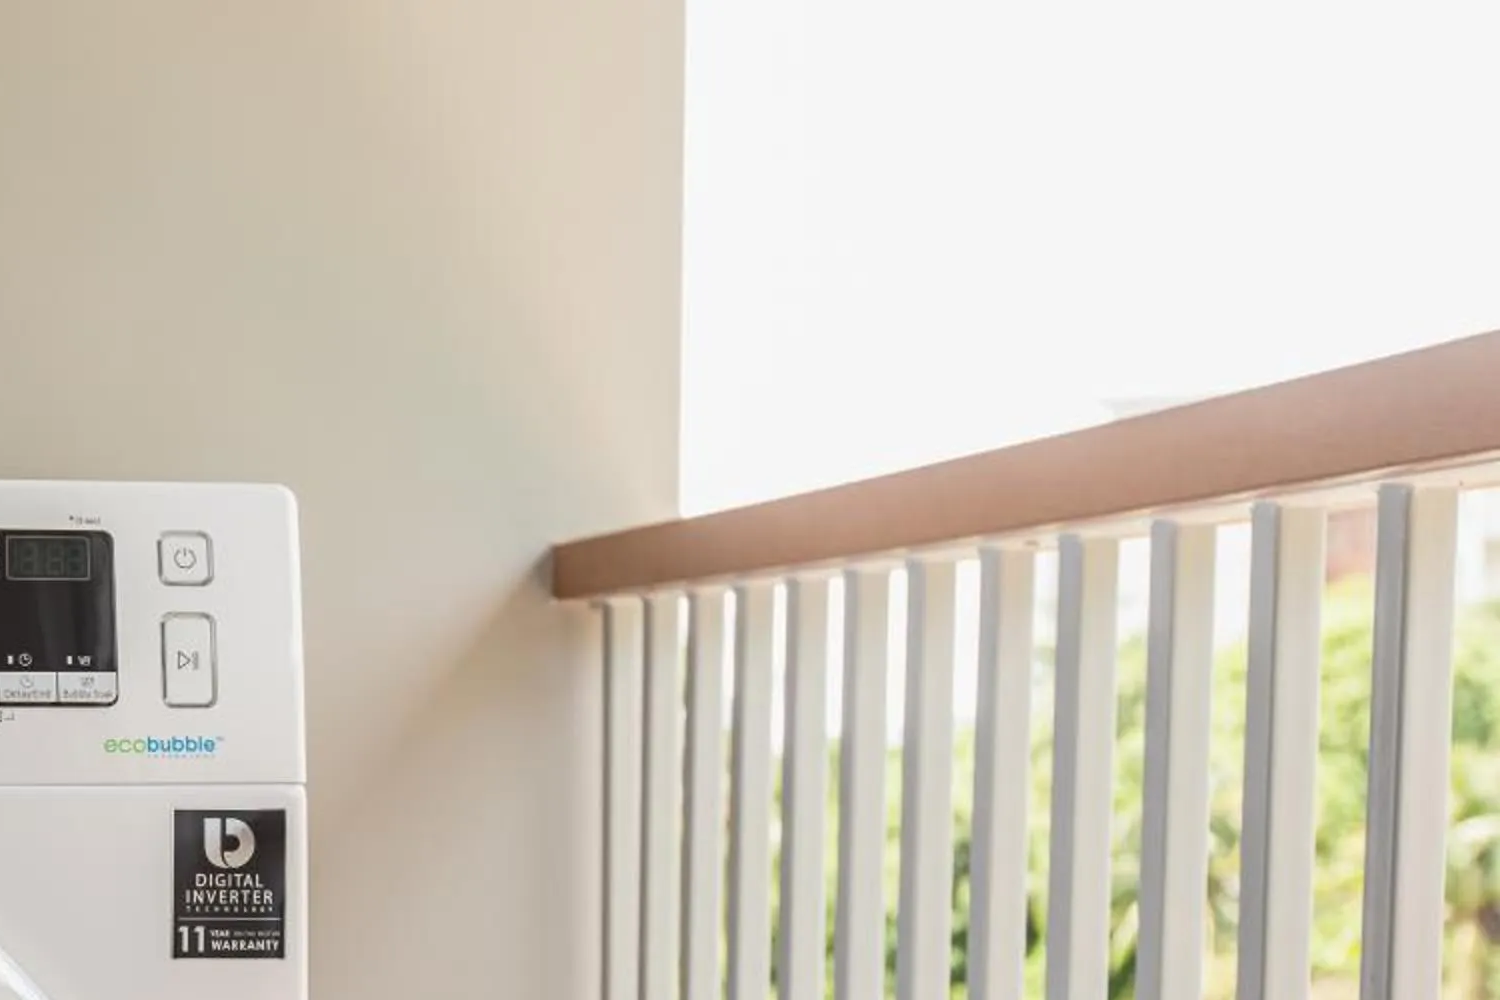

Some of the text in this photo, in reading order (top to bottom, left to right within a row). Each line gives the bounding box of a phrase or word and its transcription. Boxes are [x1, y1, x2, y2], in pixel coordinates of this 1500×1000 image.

[195, 873, 264, 888] DIGITAL
[185, 889, 274, 905] INVERTER
[179, 925, 206, 953] 11
[211, 940, 280, 951] WARRANTY
